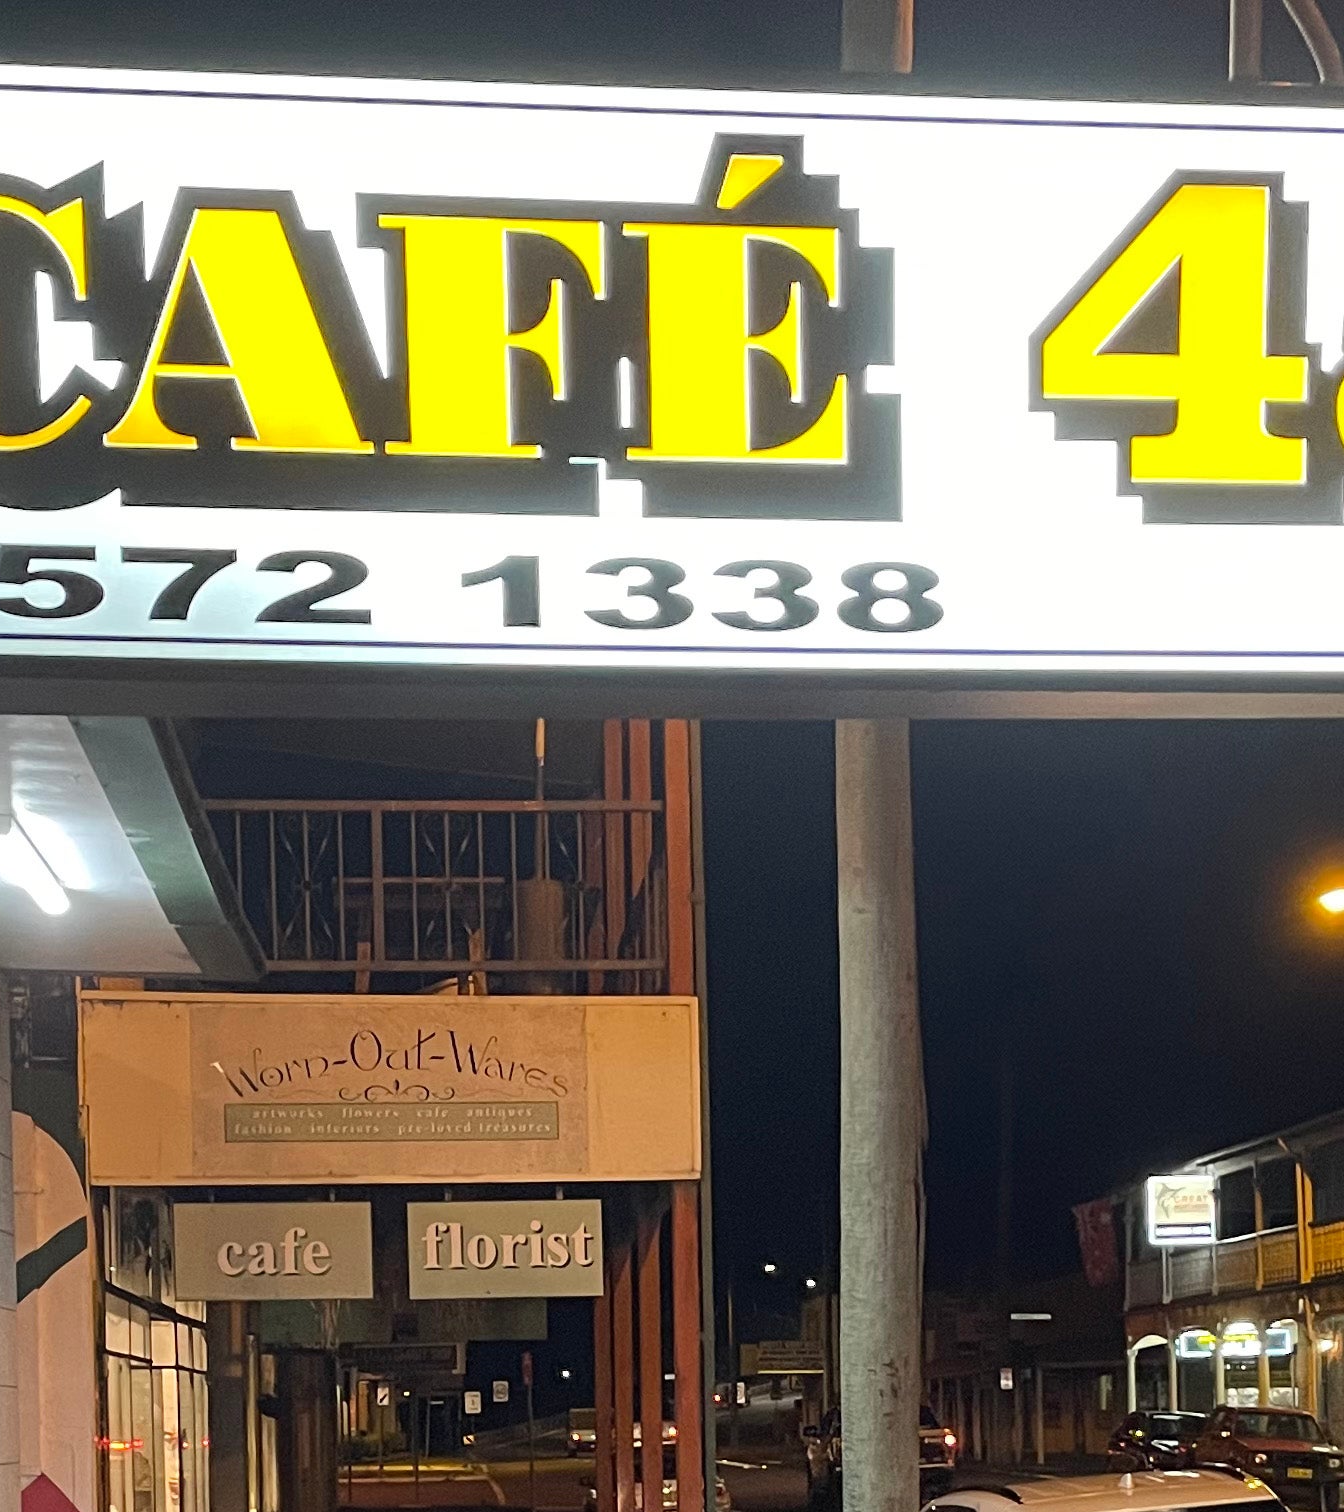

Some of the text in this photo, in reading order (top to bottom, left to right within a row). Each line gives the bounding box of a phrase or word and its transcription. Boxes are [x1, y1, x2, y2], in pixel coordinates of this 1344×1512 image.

[459, 555, 944, 632] 1338
[234, 1123, 293, 1135] fashion
[310, 1123, 380, 1135] interiors
[479, 1122, 551, 1134] treasures
[252, 1106, 533, 1121] artworks flowers cafe antiques
[217, 1227, 332, 1276] cafe
[422, 1219, 594, 1271] florist
